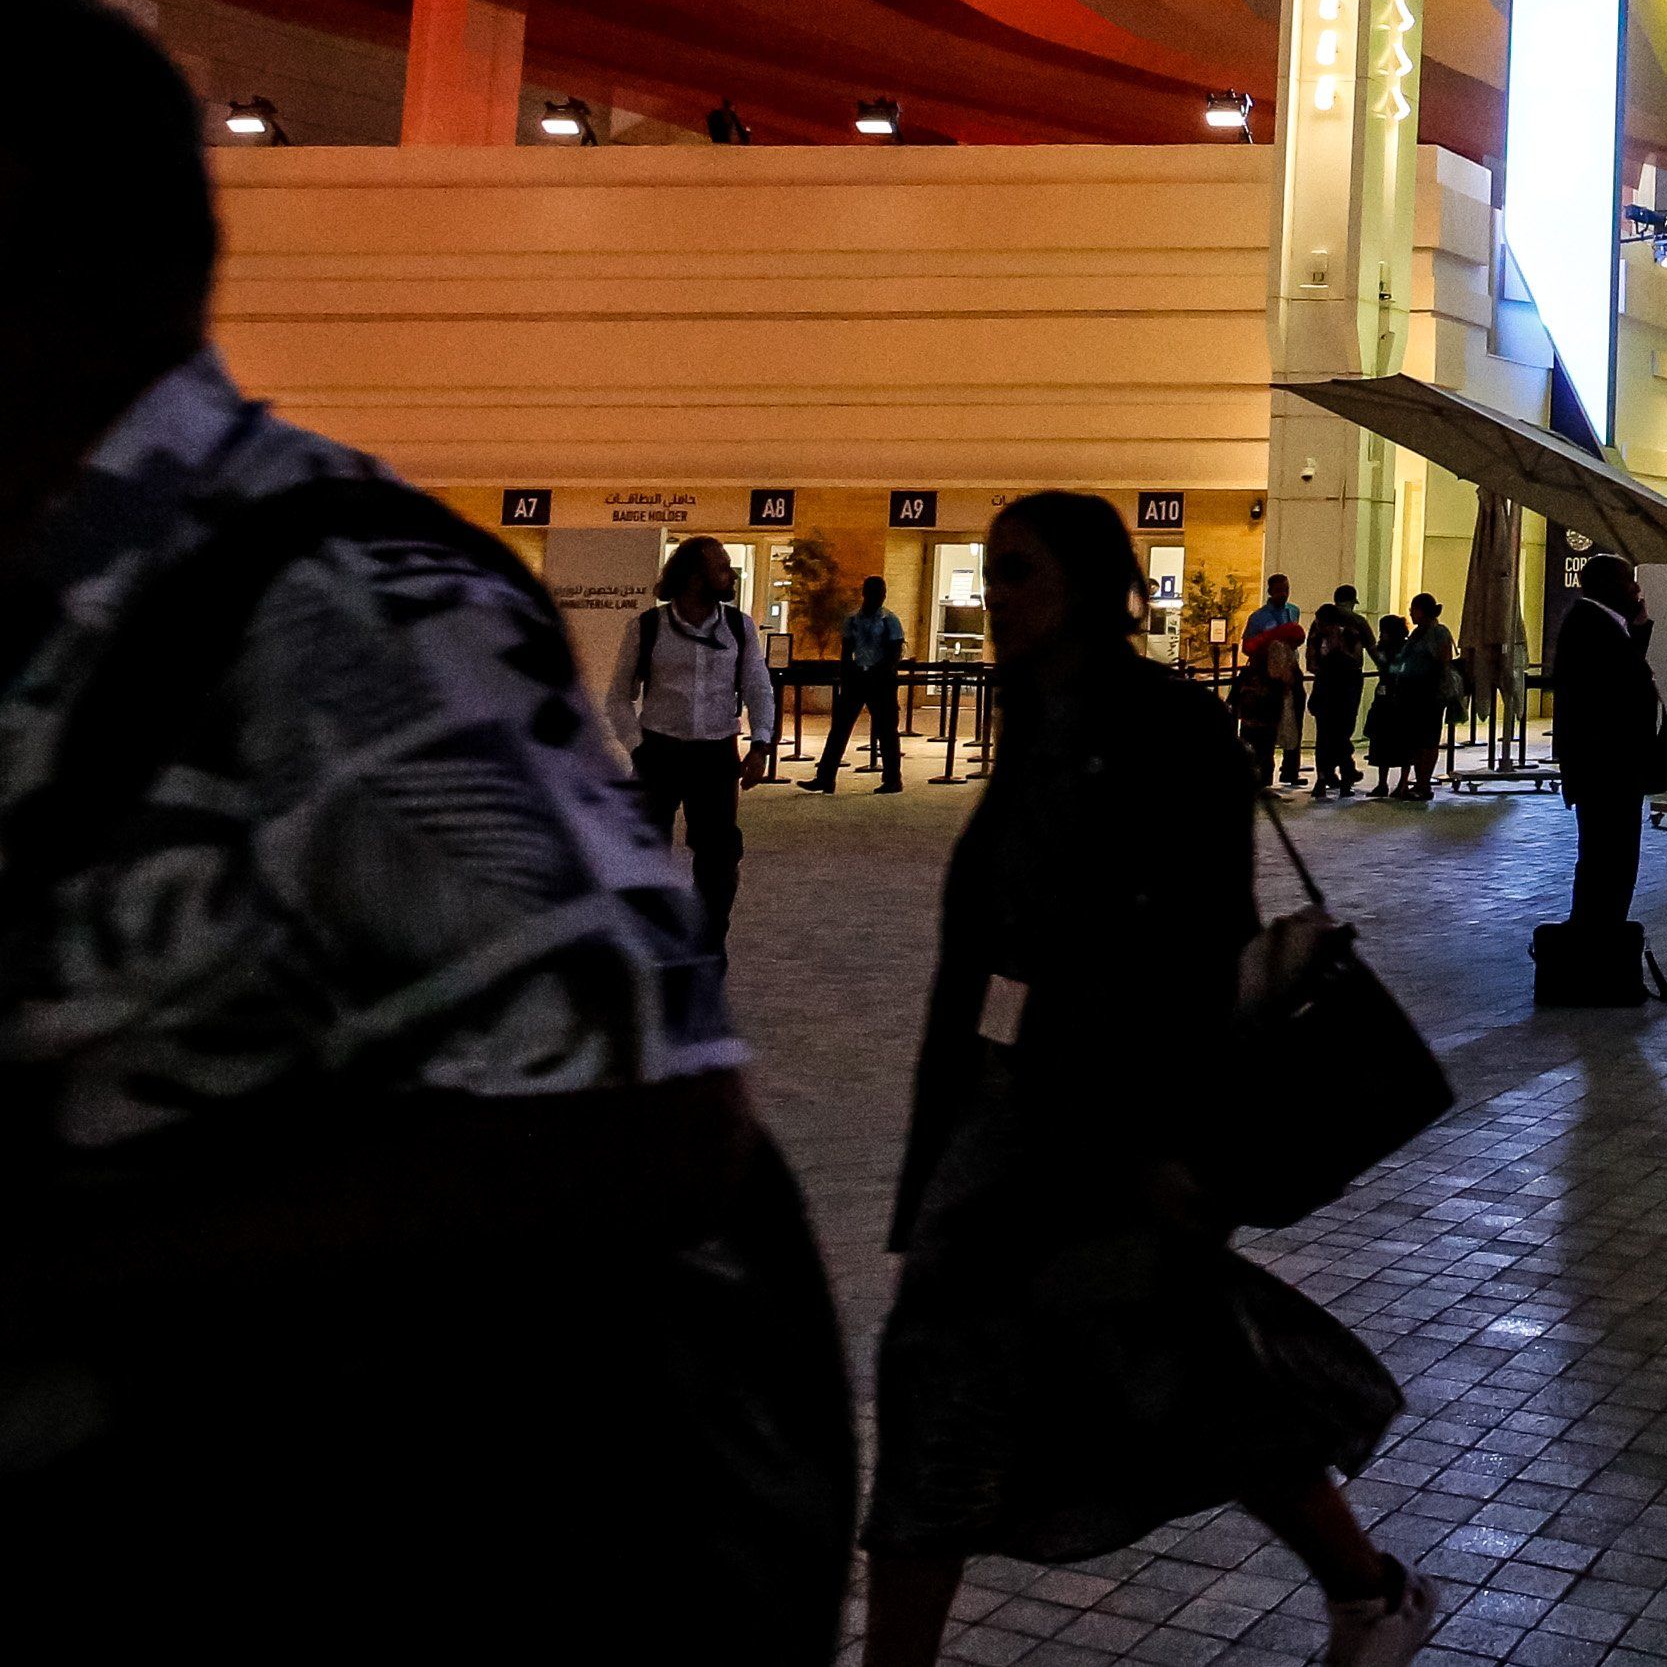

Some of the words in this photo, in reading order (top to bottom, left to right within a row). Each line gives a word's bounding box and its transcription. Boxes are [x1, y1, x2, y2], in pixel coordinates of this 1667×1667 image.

[514, 498, 537, 518] A7
[612, 510, 646, 522] BADGE
[648, 510, 688, 522] HOLDER
[762, 498, 785, 518] A8
[900, 498, 924, 518] A9
[1145, 499, 1180, 520] A10
